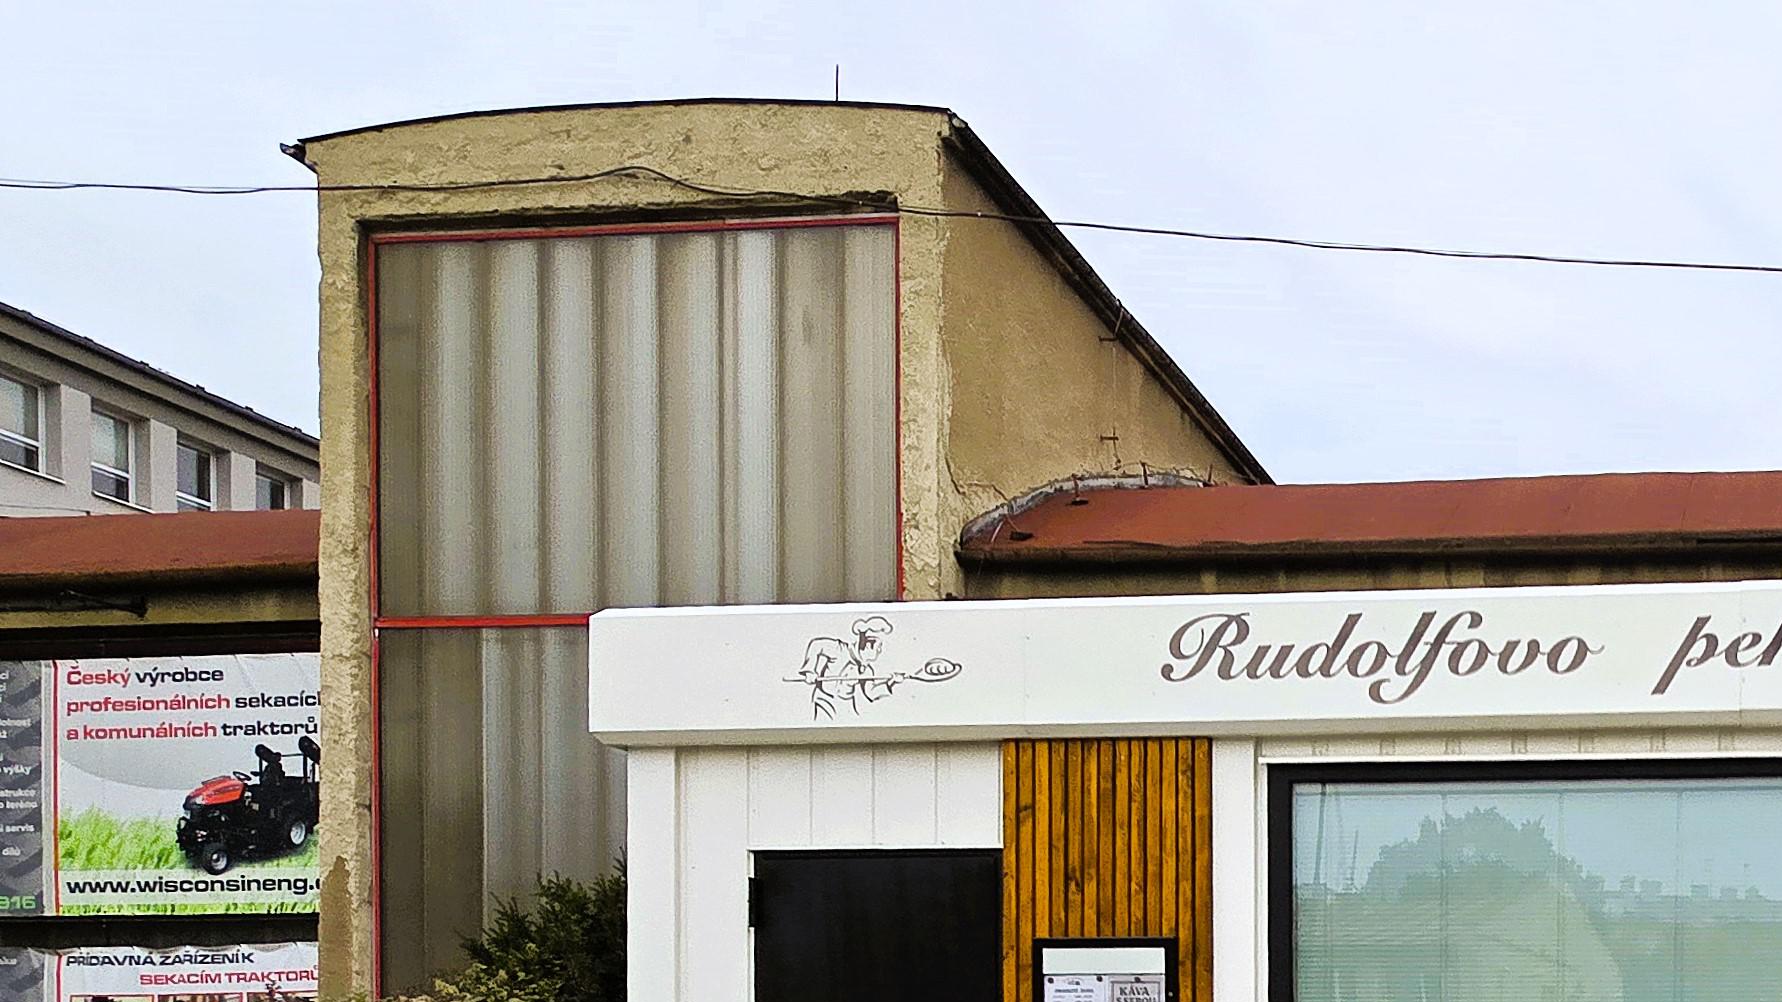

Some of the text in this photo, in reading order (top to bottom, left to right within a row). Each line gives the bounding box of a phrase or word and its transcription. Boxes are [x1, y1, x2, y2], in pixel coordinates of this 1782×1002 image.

[1160, 611, 1604, 704] Rudolfovo
[67, 666, 224, 688] Český výrobce
[67, 693, 230, 716] profesionálních
[67, 716, 318, 740] a komunálních traktorů
[66, 949, 254, 967] PŘÍDAVNÁ ZAŘÍZENÍ K
[140, 970, 222, 985] SEKACÍM
[1119, 984, 1149, 996] KÁVA
